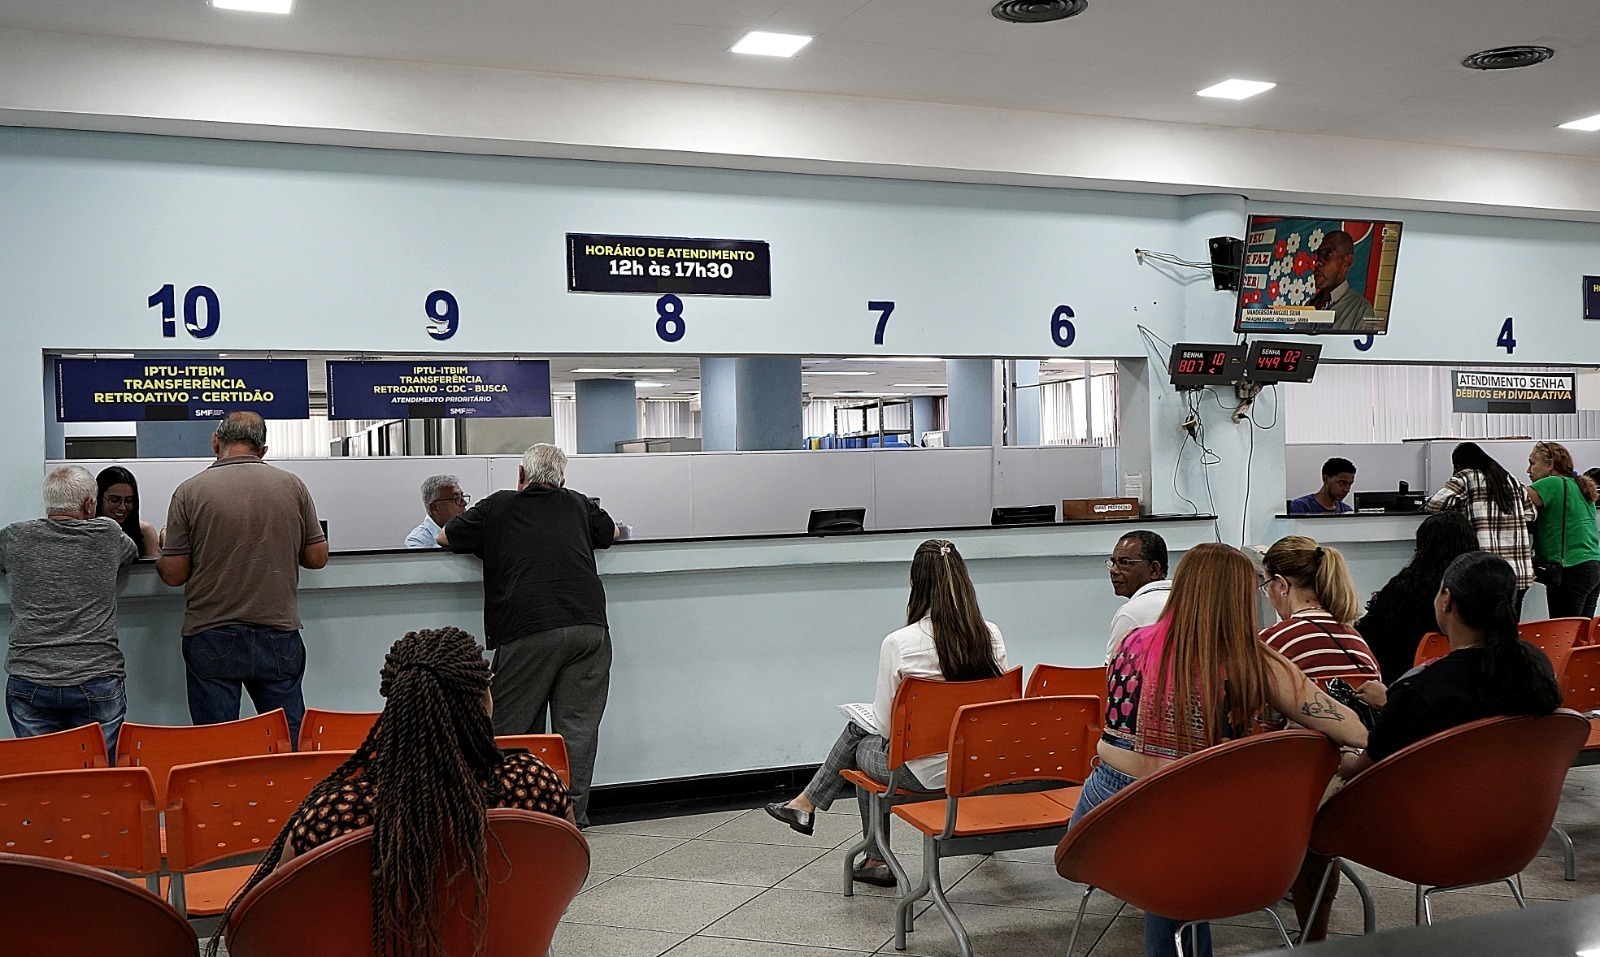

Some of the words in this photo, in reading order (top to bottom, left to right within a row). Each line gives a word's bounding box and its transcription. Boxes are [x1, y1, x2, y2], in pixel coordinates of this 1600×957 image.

[585, 243, 646, 257] HORÁRIO
[648, 248, 665, 258] DE
[666, 248, 755, 261] ATENDIMENTO
[1252, 254, 1269, 264] FAZ
[609, 259, 644, 276] 12h
[648, 260, 671, 277] às
[674, 262, 733, 278] 17h30
[148, 284, 221, 340] 10
[425, 290, 459, 340] 9
[655, 294, 686, 342] 8
[868, 301, 895, 345] 7
[1051, 305, 1075, 347] 6
[1496, 317, 1516, 354] 4
[1261, 348, 1281, 356] SENHA
[1283, 350, 1301, 363] 02
[1212, 353, 1225, 366] 10
[1257, 357, 1281, 369] 449
[144, 366, 225, 377] IPTU-ITBIM
[413, 366, 468, 375] IPTU-ITBIM
[1178, 360, 1204, 373] 807
[124, 377, 246, 389] TRANSFERÊNCIA
[400, 374, 482, 385] TRANSFERÊNCIA
[1460, 374, 1527, 387] ATENDIMENTO
[1530, 378, 1565, 389] SENHA
[94, 392, 190, 403] RETROATIVO
[202, 389, 275, 402] CERTIDÃO
[373, 385, 438, 394] RETROATIVO
[446, 385, 467, 393] CDC
[475, 385, 508, 393] BUSCA
[1456, 386, 1492, 398] DÉBITOS
[1493, 390, 1507, 399] EM
[1508, 388, 1540, 399] DÍVIDA
[1541, 390, 1572, 400] ATIVA
[391, 396, 445, 404] ATENDIMENTO
[445, 395, 492, 403] PRIORITÁRIO
[195, 409, 212, 417] SMF
